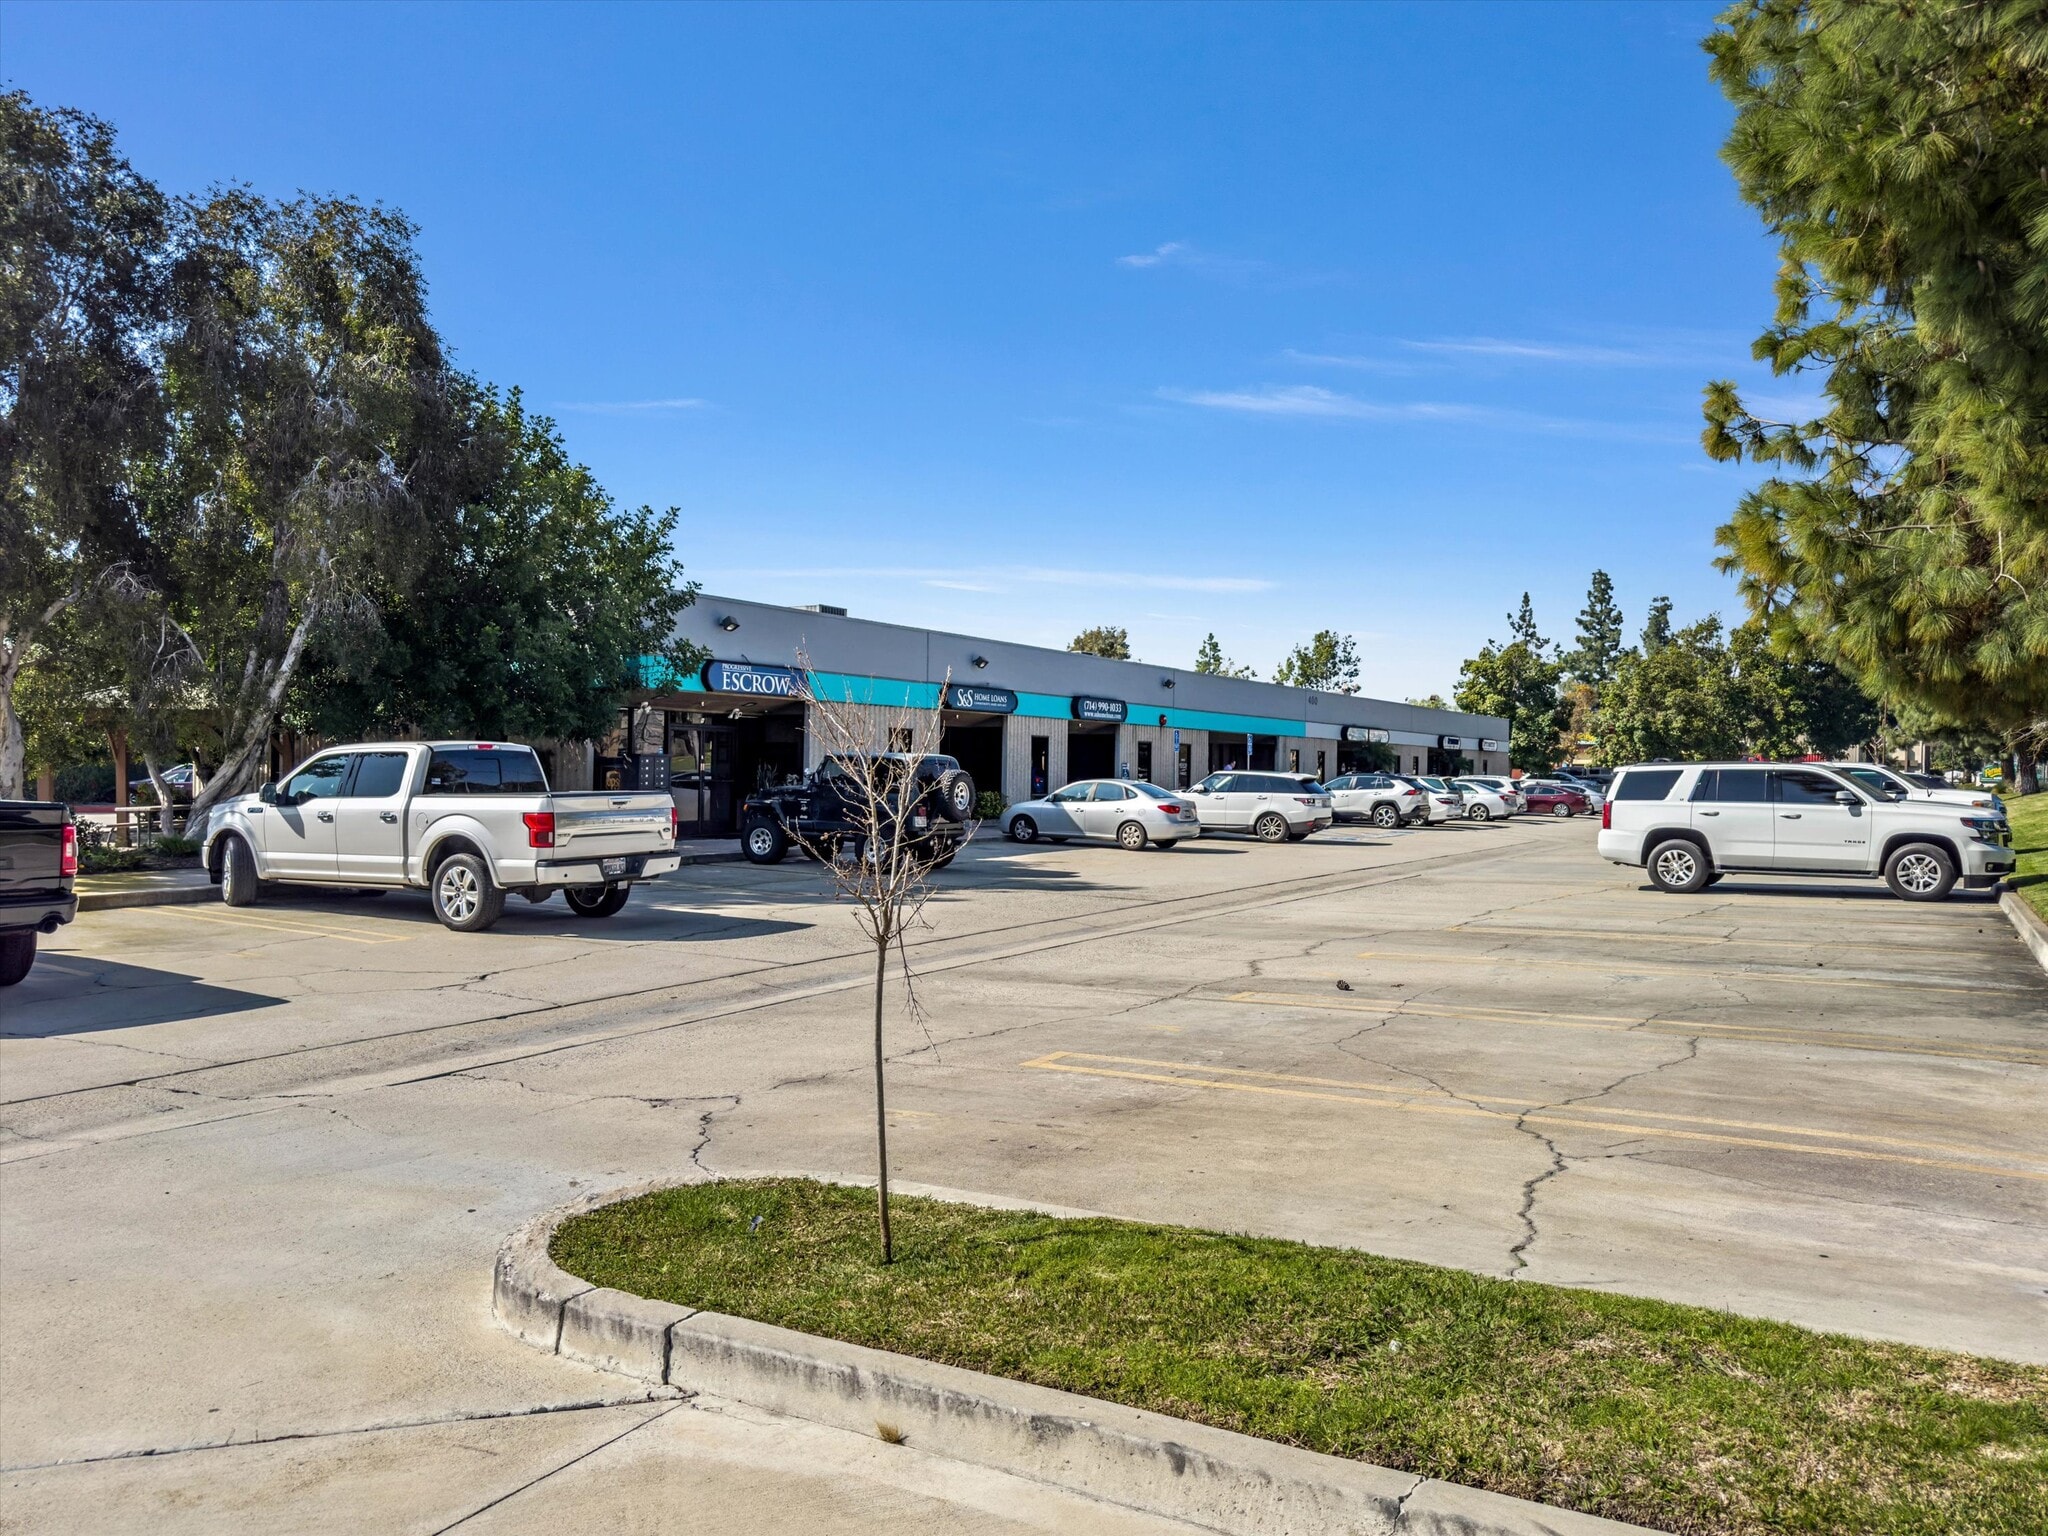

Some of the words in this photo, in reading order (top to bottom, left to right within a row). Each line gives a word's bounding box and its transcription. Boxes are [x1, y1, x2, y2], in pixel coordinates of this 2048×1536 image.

[722, 663, 752, 672] PROGRESSIVE
[722, 671, 791, 695] ESCROW
[974, 692, 990, 702] HOME
[991, 695, 1008, 704] LOANS
[1083, 700, 1097, 711] (714)
[1097, 701, 1122, 713] 990-1033
